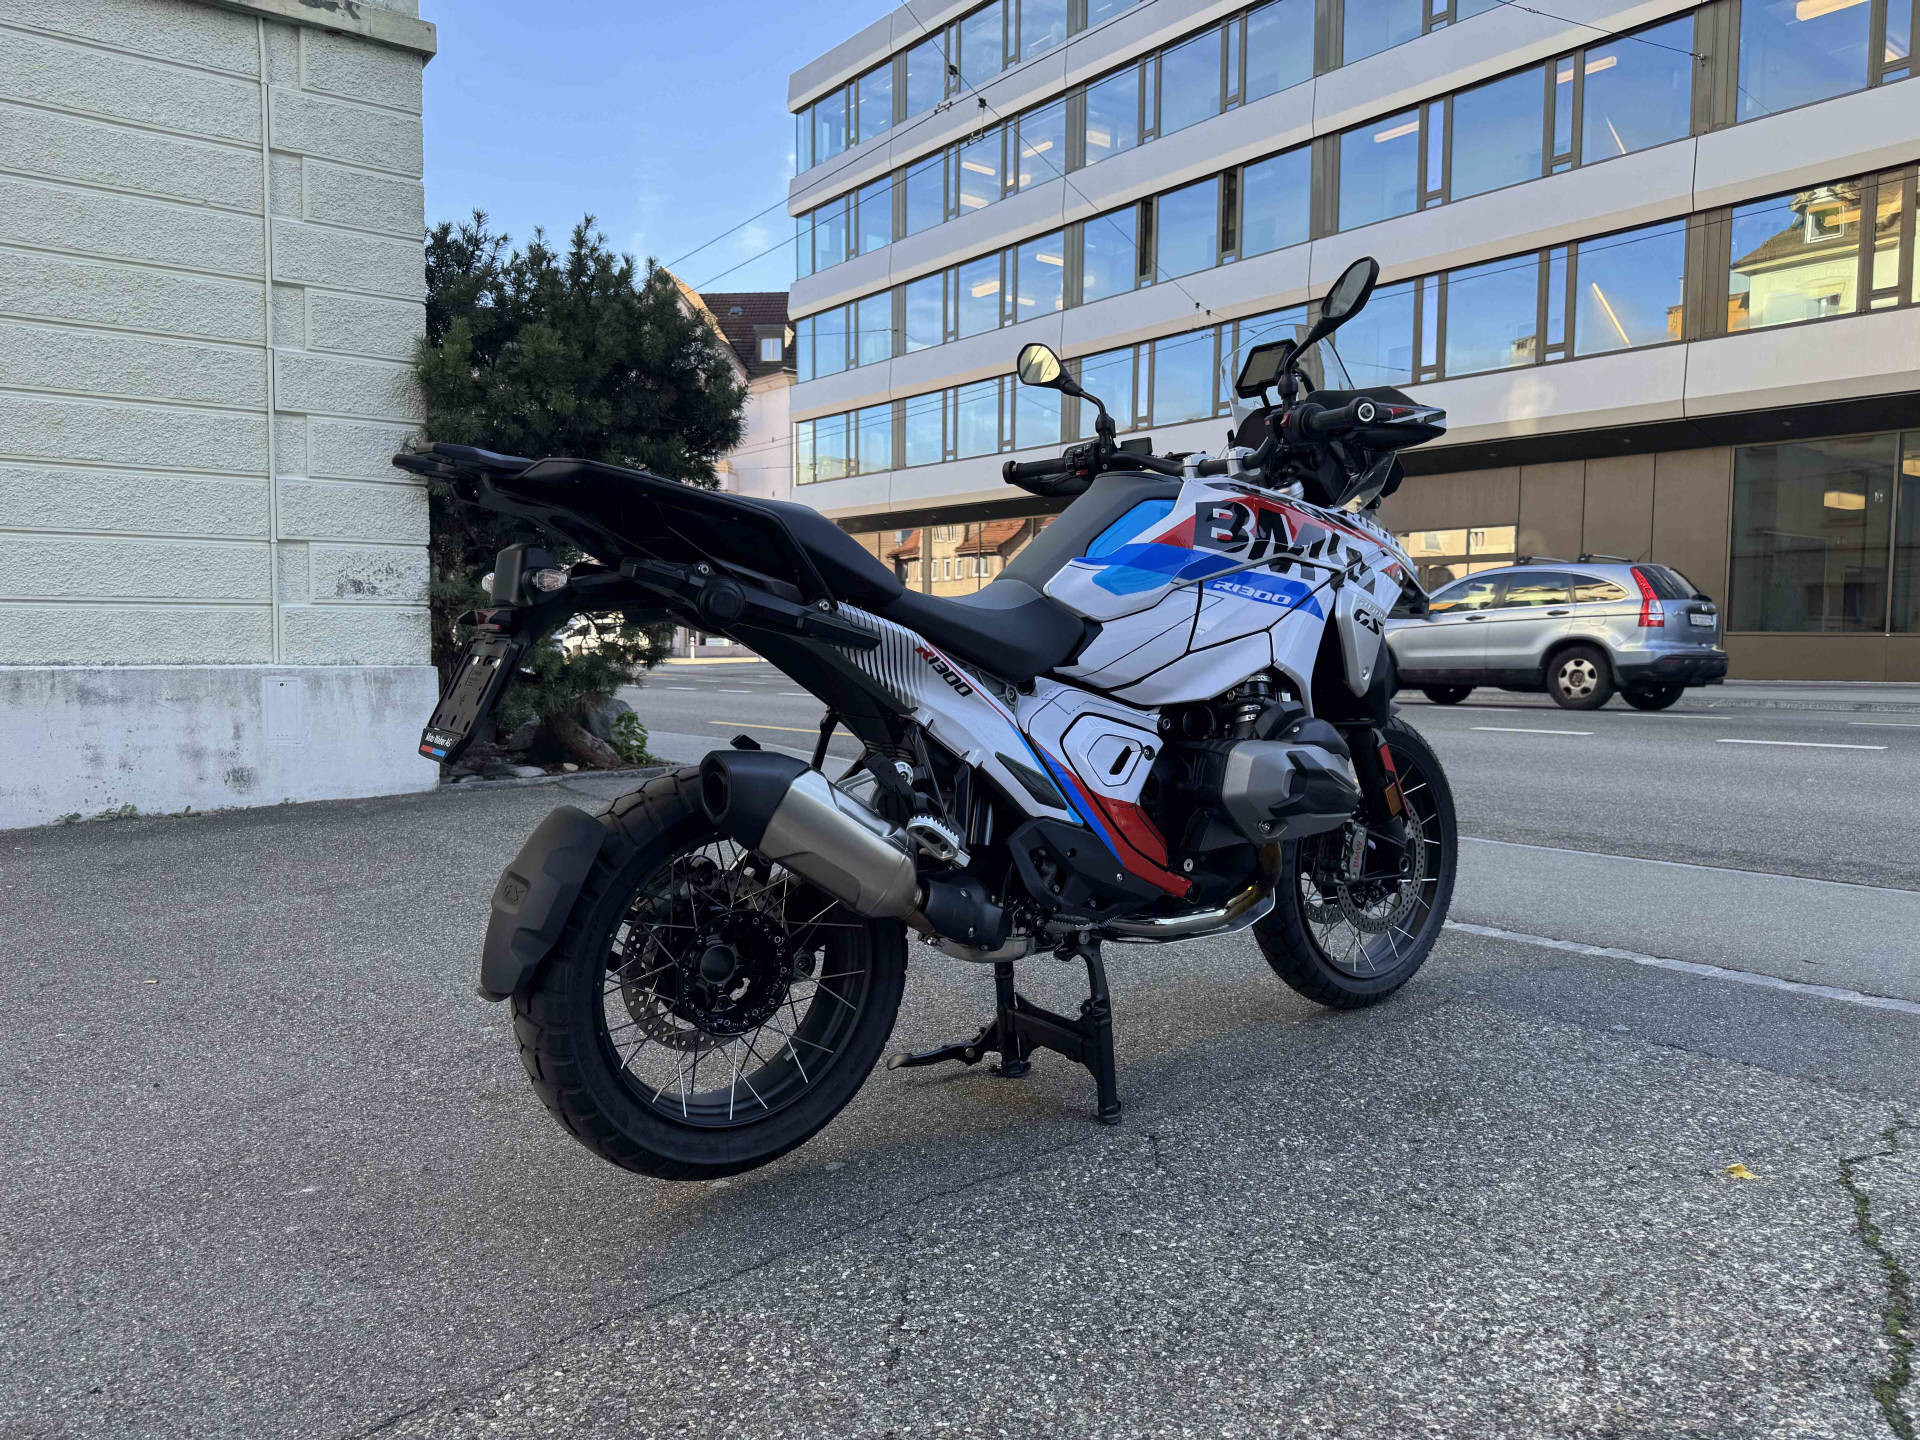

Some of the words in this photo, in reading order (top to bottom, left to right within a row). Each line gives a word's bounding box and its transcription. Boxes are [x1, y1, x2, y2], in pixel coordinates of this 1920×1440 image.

[1213, 580, 1292, 605] R1300
[1353, 608, 1384, 636] GS
[914, 646, 974, 697] R1300
